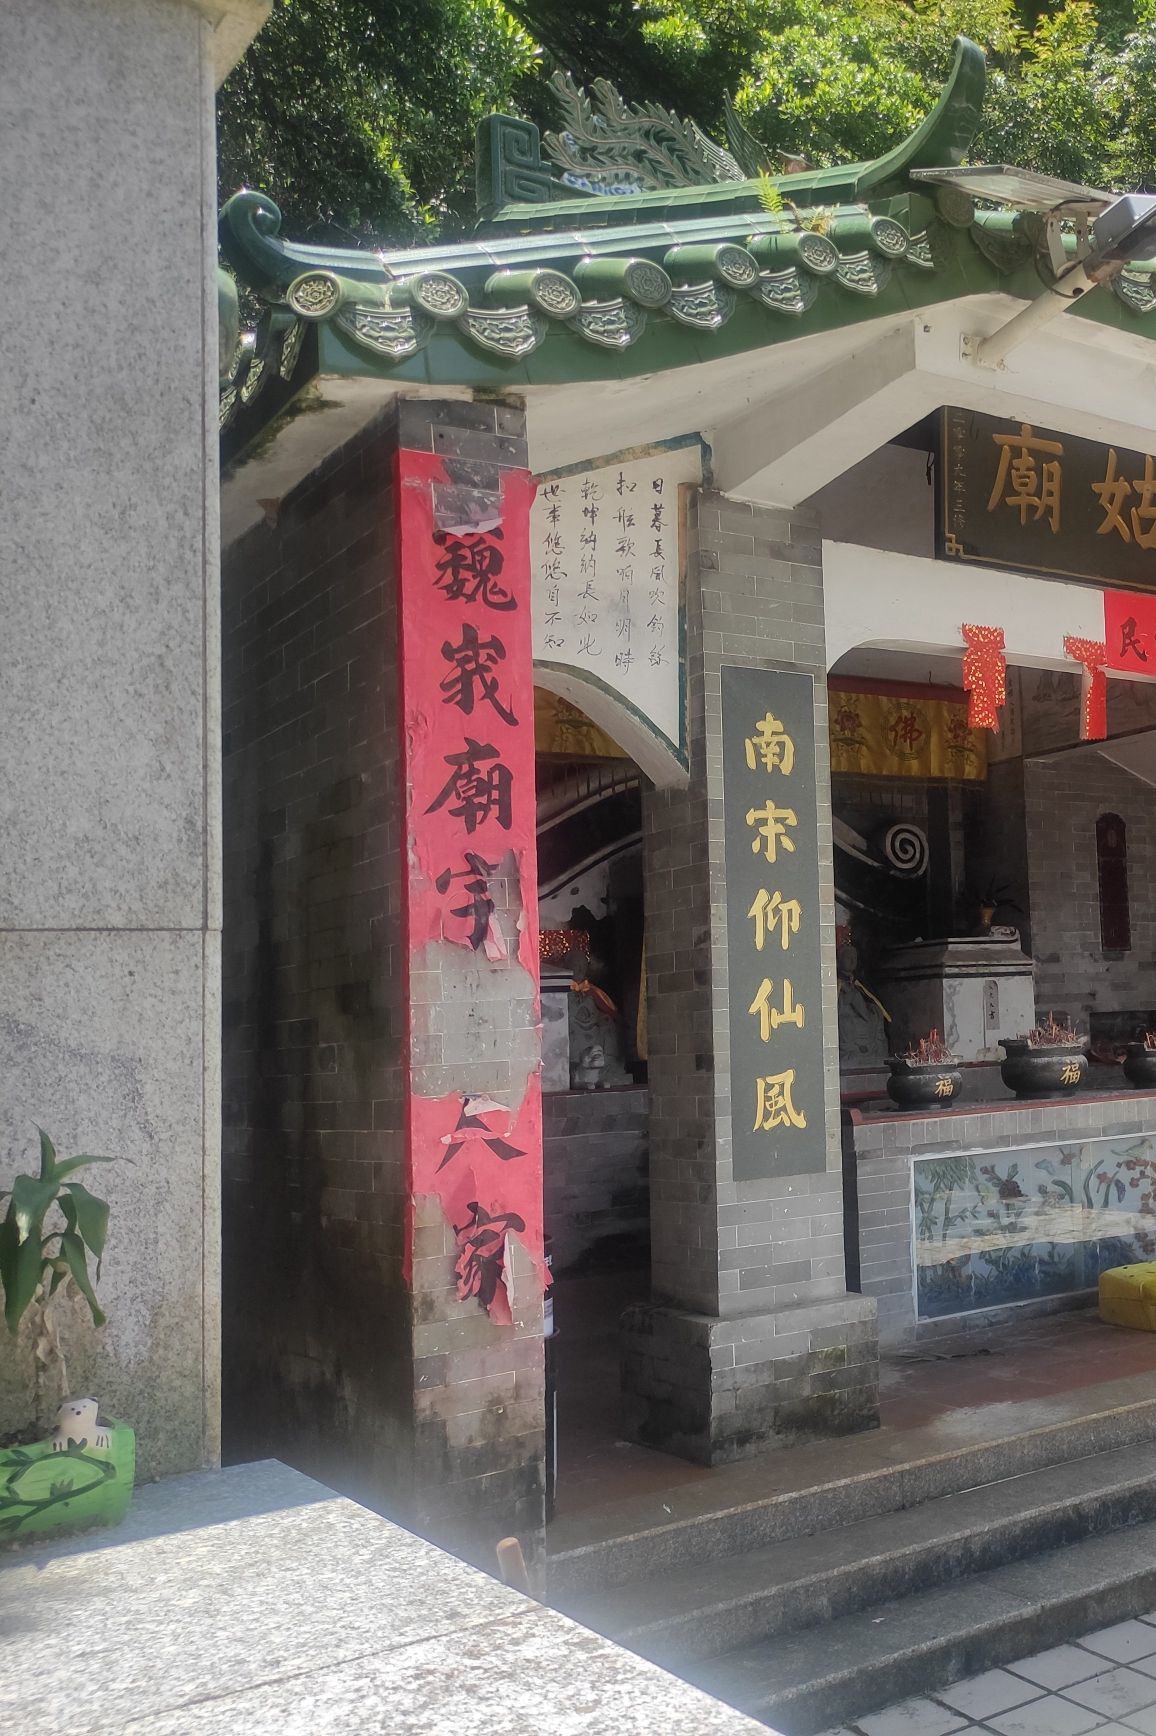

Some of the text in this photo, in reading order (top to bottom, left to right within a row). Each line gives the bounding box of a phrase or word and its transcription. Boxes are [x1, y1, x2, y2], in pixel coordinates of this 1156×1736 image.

[888, 711, 924, 752] 佛
[744, 711, 808, 1133] 南宋仰仙風
[934, 1076, 954, 1098] 福
[1060, 1060, 1081, 1086] 福
